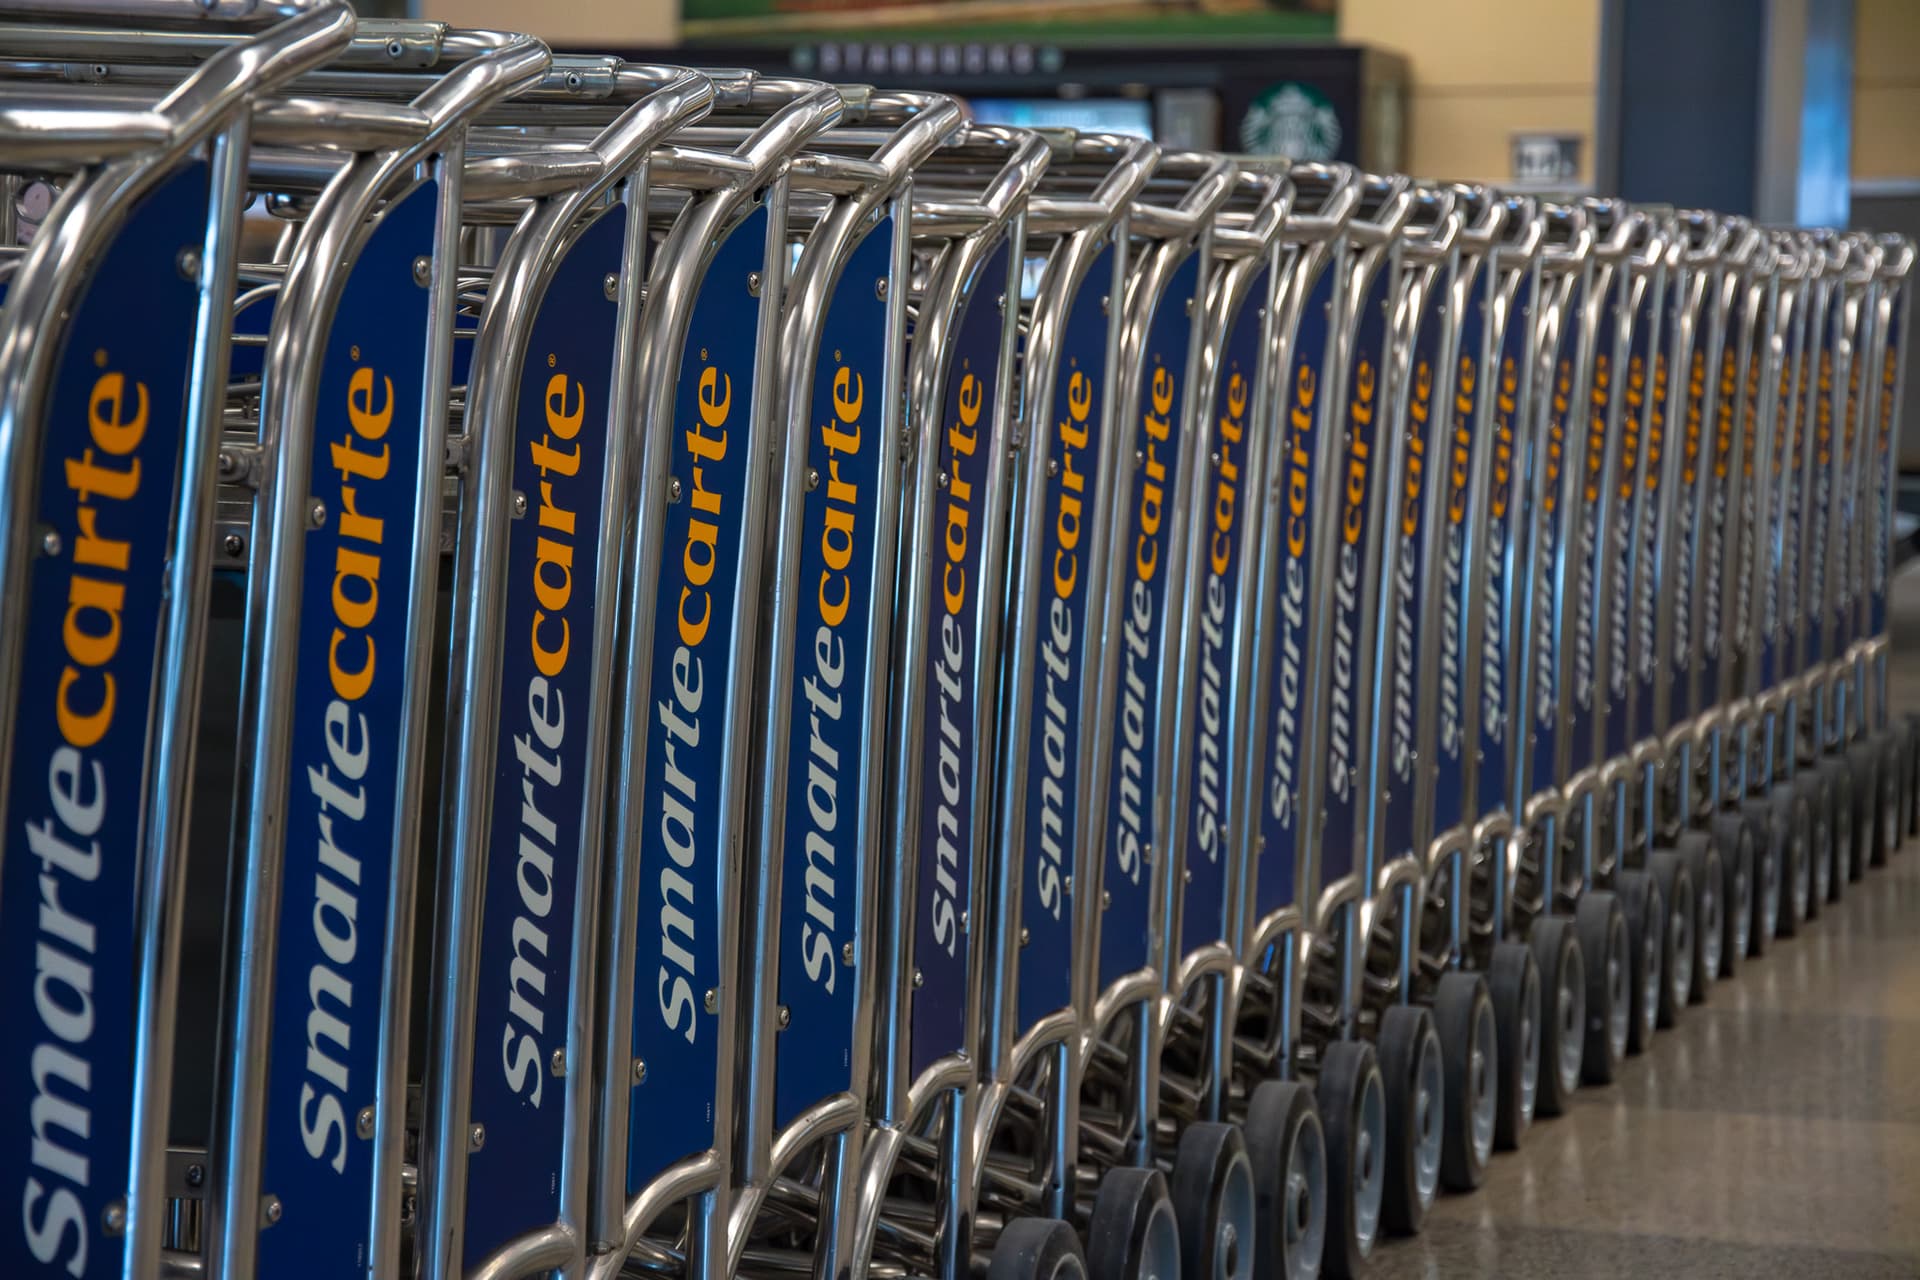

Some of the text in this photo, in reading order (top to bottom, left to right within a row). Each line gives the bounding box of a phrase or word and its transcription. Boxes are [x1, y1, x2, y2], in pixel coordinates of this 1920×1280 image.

[24, 371, 149, 1277] smartecarte
[300, 367, 394, 1172] smartecarte
[503, 373, 585, 1107] smartecarte
[658, 367, 731, 1043] smartecarte
[803, 367, 863, 993] smartecarte
[933, 374, 981, 956] smartecarte
[1037, 377, 1091, 920] smartecarte
[1116, 366, 1174, 885] smartecarte
[1198, 368, 1247, 862] smartecarte
